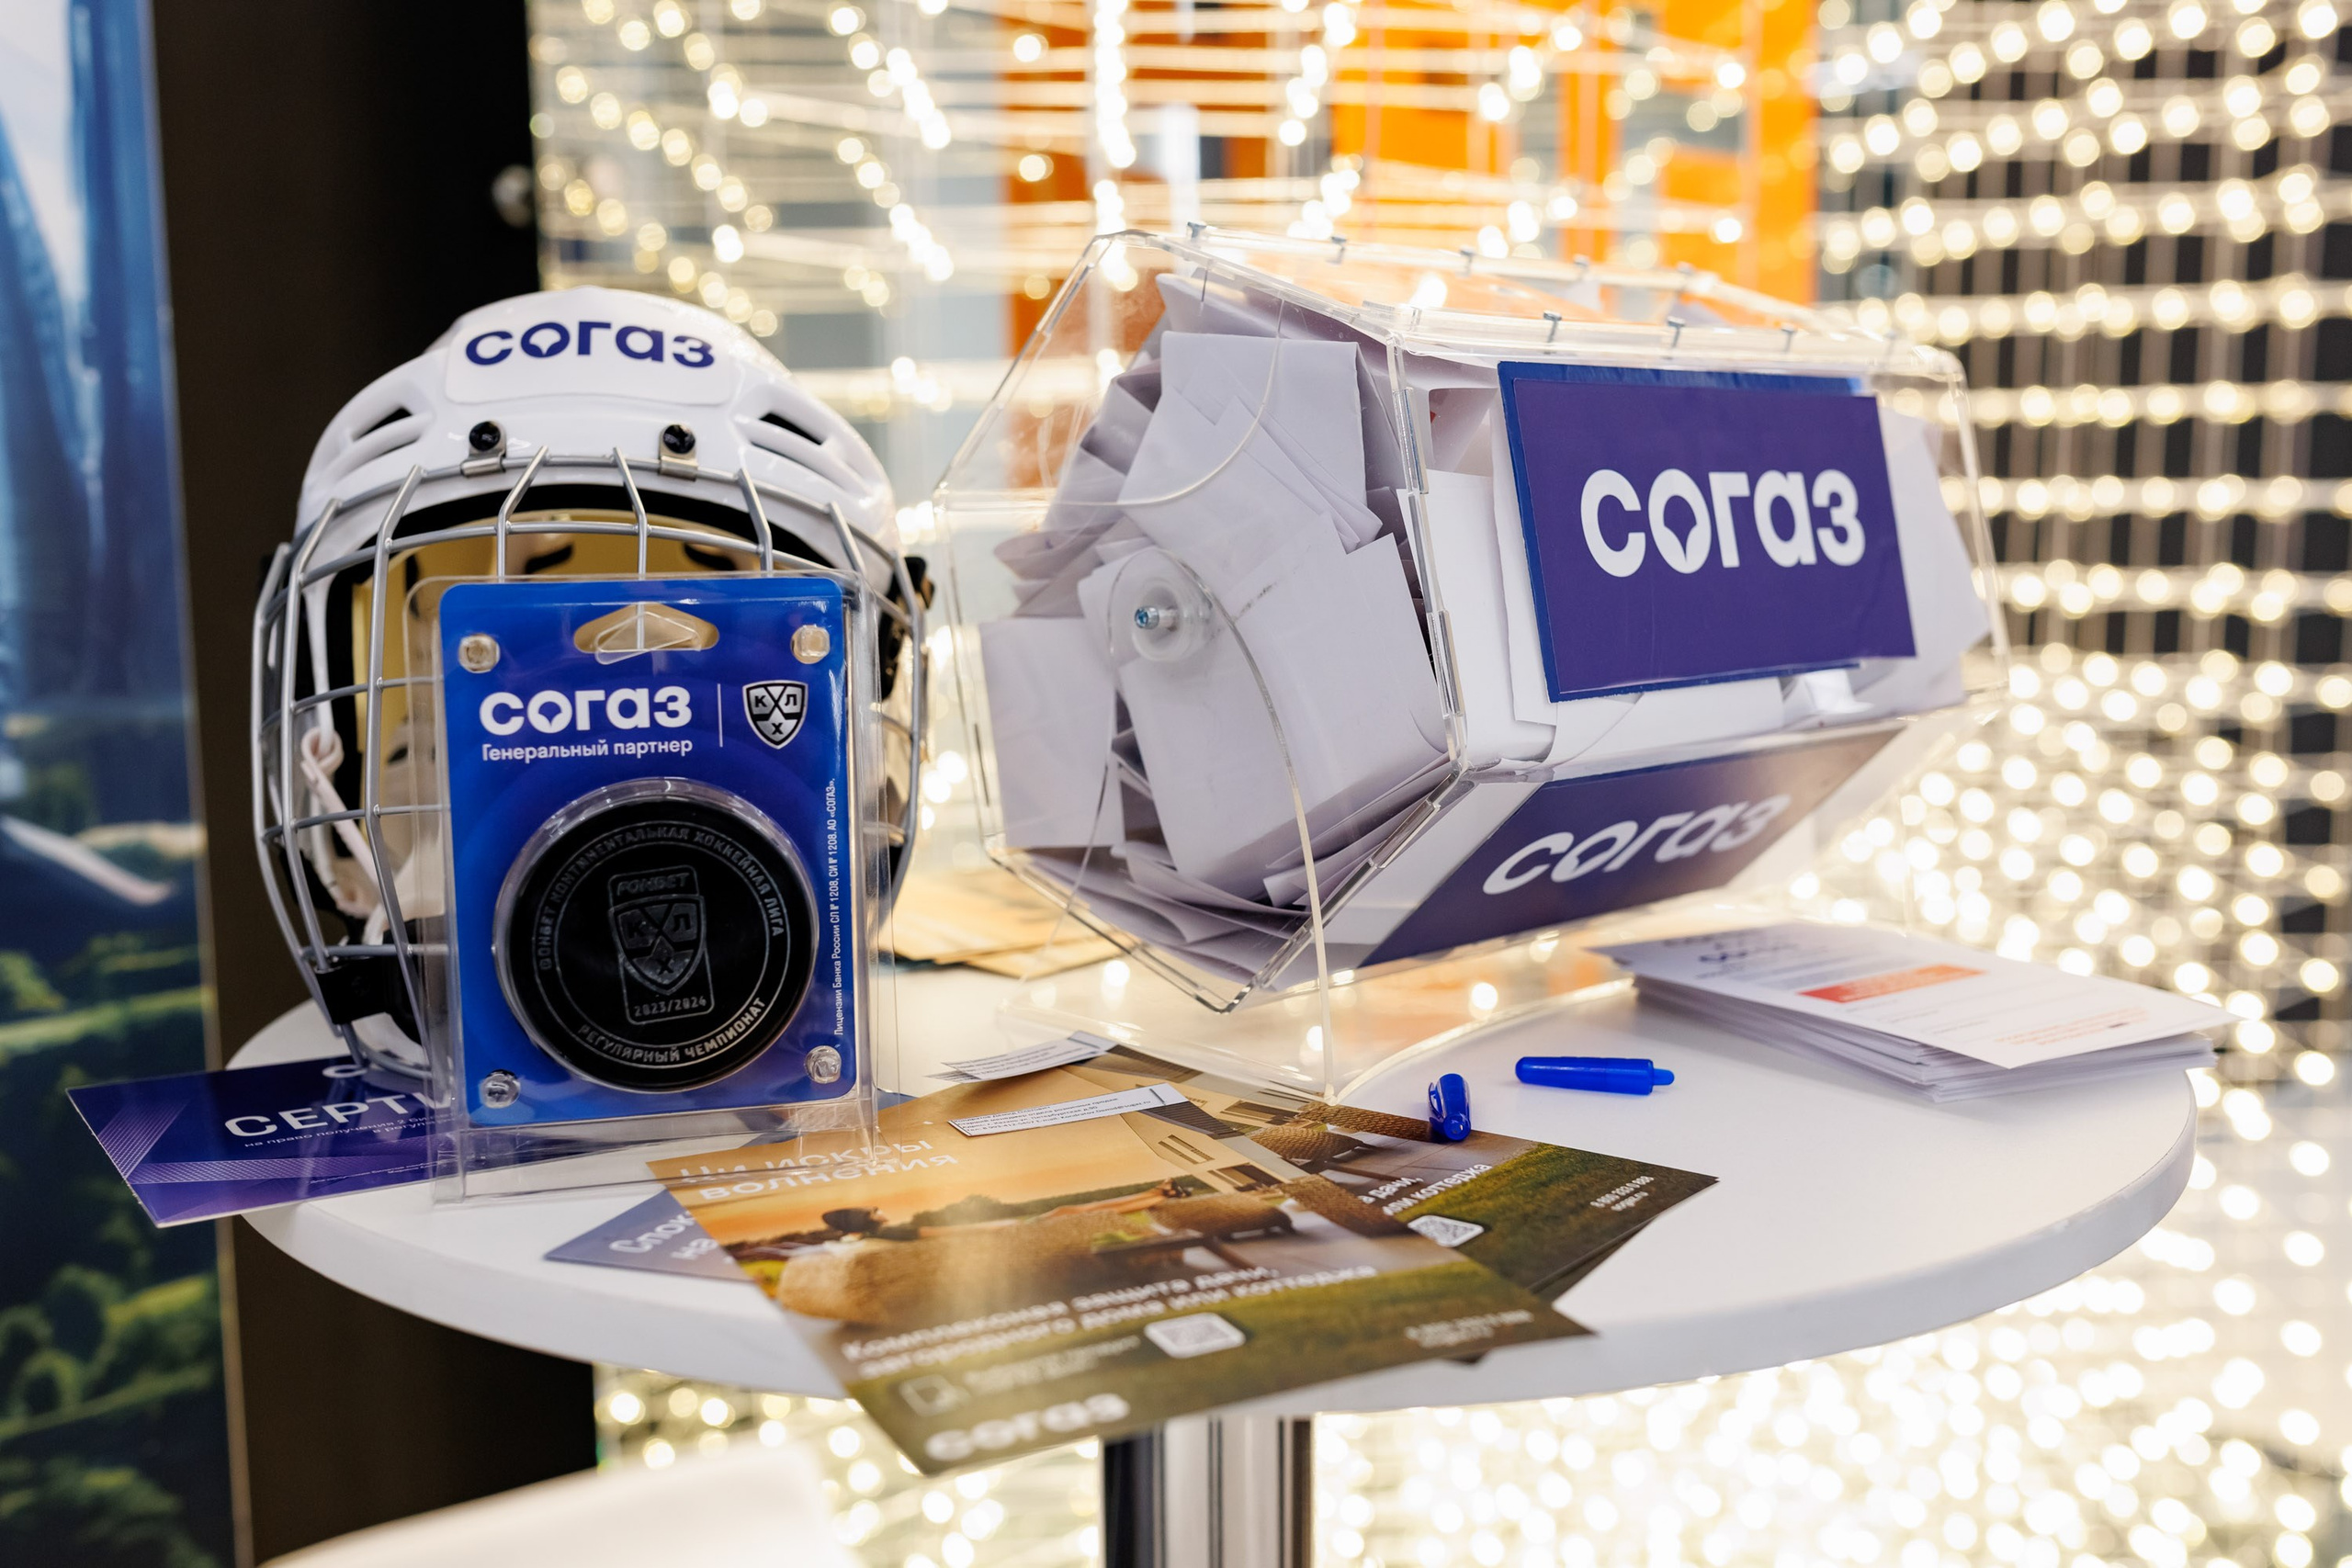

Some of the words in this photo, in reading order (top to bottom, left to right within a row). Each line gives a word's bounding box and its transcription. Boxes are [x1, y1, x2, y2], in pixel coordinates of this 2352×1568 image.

[481, 739, 609, 763] Генеральный
[613, 739, 693, 759] партнер
[827, 819, 837, 830] АО
[827, 831, 838, 855] 1208.
[829, 864, 839, 877] СИ
[695, 830, 772, 895] ХОККЕЙНАЯ
[763, 897, 785, 937] ЛИГА
[829, 878, 840, 902] 1208,
[830, 911, 840, 923] СЛ
[831, 924, 842, 959] России
[832, 960, 842, 988] Банка
[834, 989, 844, 1035] Лицензии
[578, 1024, 680, 1063] РЕГУЛЯРНЫЙ
[684, 998, 766, 1058] ЧЕМПИОНАТ
